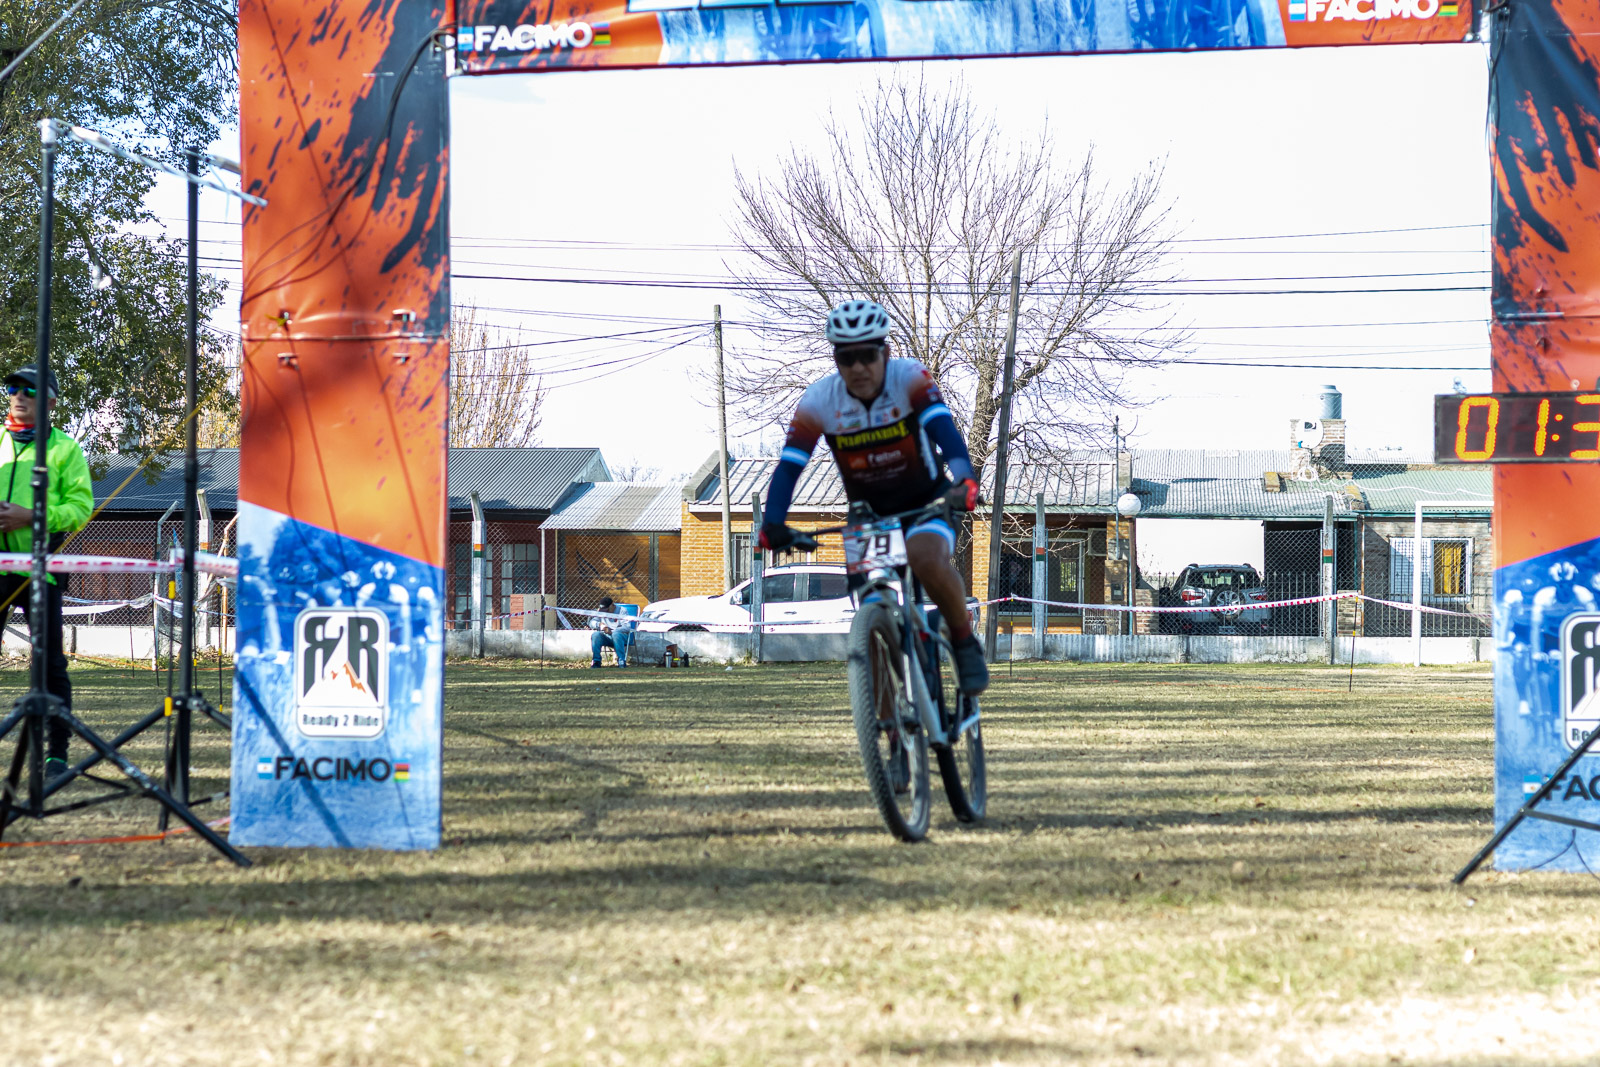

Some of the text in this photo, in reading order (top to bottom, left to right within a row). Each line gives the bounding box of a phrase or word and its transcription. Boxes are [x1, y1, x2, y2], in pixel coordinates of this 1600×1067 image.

[1307, 0, 1439, 22] FACIMO
[474, 22, 593, 51] FACIMO
[857, 534, 891, 559] 79
[303, 714, 338, 727] Ready
[353, 715, 379, 727] Ride
[275, 756, 391, 782] FACIMO
